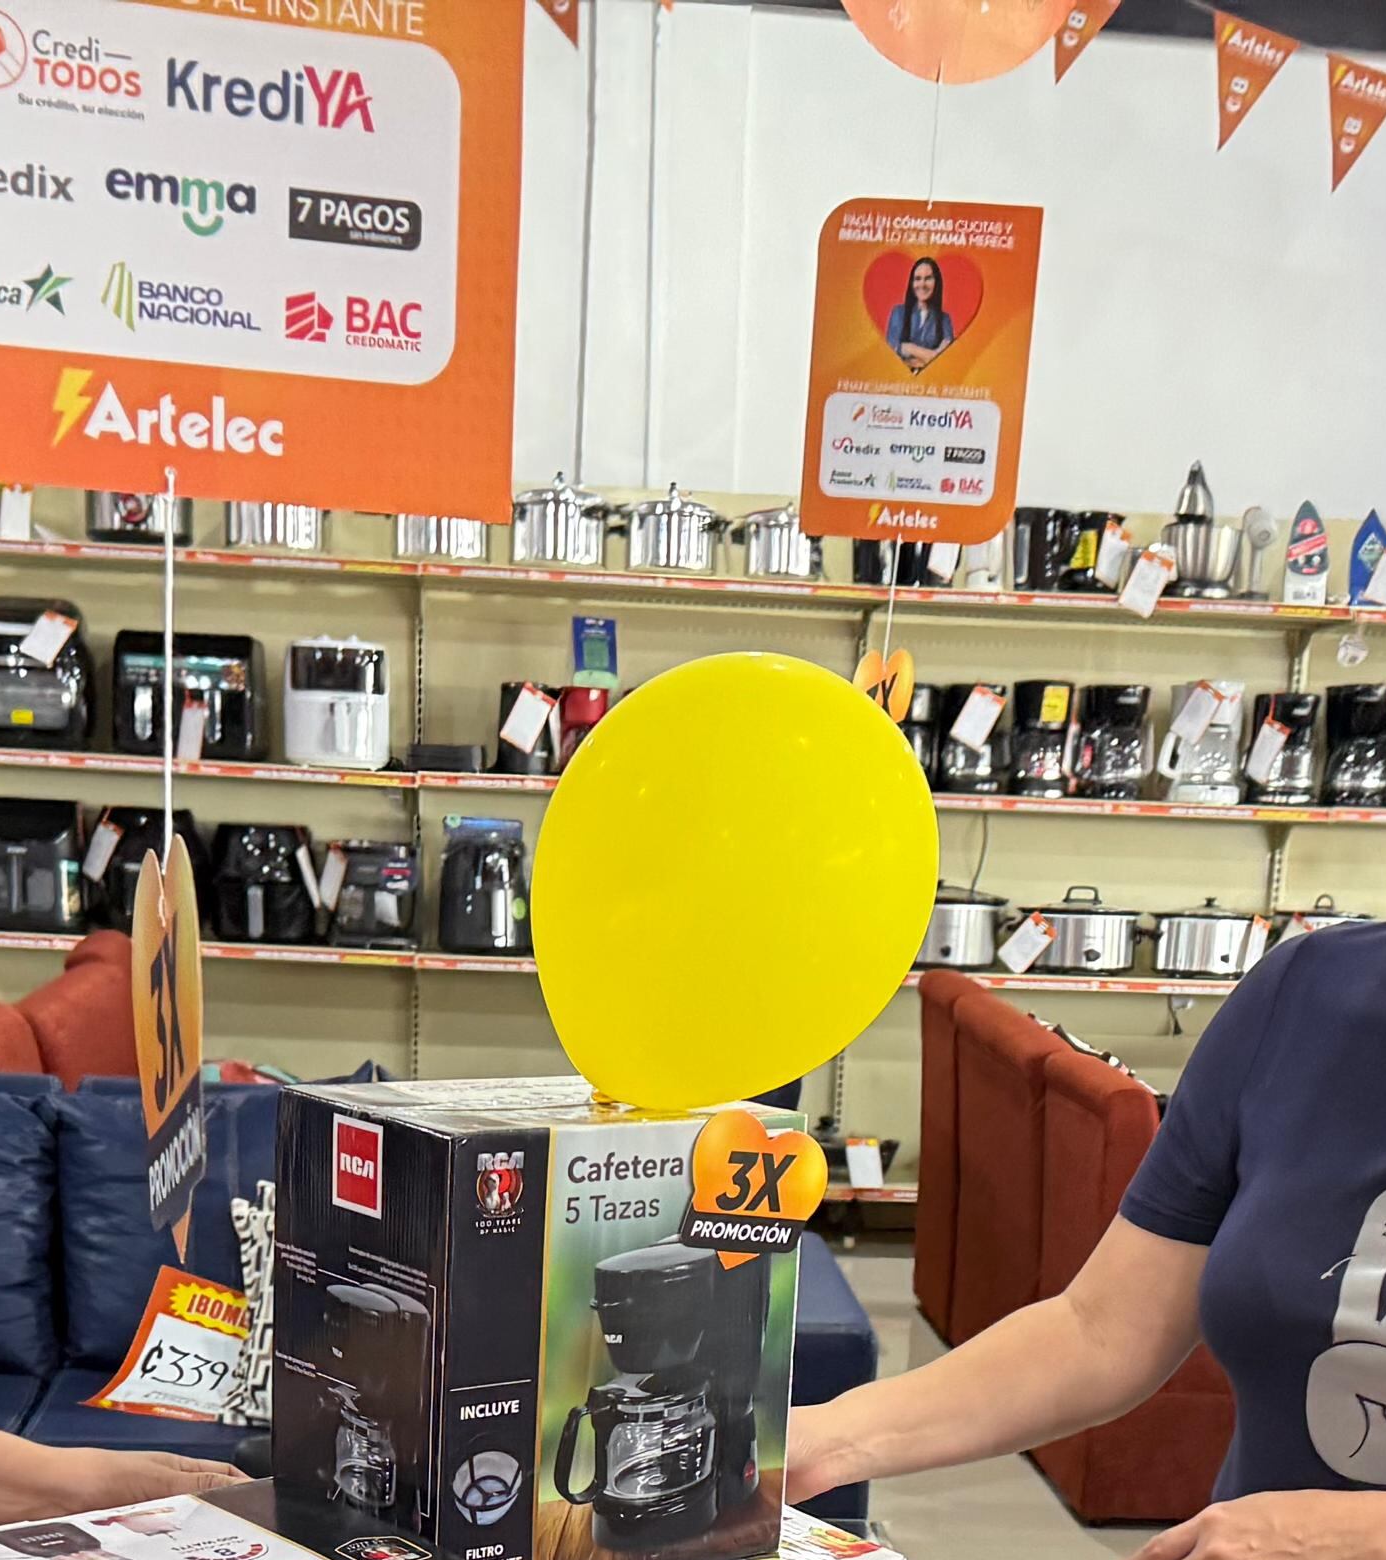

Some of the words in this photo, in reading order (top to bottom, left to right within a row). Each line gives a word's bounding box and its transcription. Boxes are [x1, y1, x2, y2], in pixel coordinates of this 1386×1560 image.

[33, 58, 142, 98] TODOS
[166, 57, 375, 133] KrediYA
[104, 167, 257, 215] emma
[296, 196, 313, 223] 7
[319, 200, 411, 234] PAGOS
[138, 281, 223, 307] BANCO
[138, 302, 262, 332] NACIONAL
[345, 295, 423, 340] BAC
[345, 334, 423, 352] CREDOMATIC
[82, 381, 284, 457] Artelec
[909, 409, 974, 429] KrediYA
[877, 504, 939, 530] Artelec
[340, 1151, 375, 1182] RCA
[476, 1151, 525, 1171] RCA
[566, 1151, 685, 1186] Cafetera
[714, 1149, 798, 1214] 3X
[565, 1197, 581, 1225] 5
[590, 1191, 661, 1223] Tazas
[689, 1219, 793, 1245] PROMOCIÓN
[459, 1399, 521, 1421] INCLUYE
[465, 1543, 505, 1560] FILTRO
